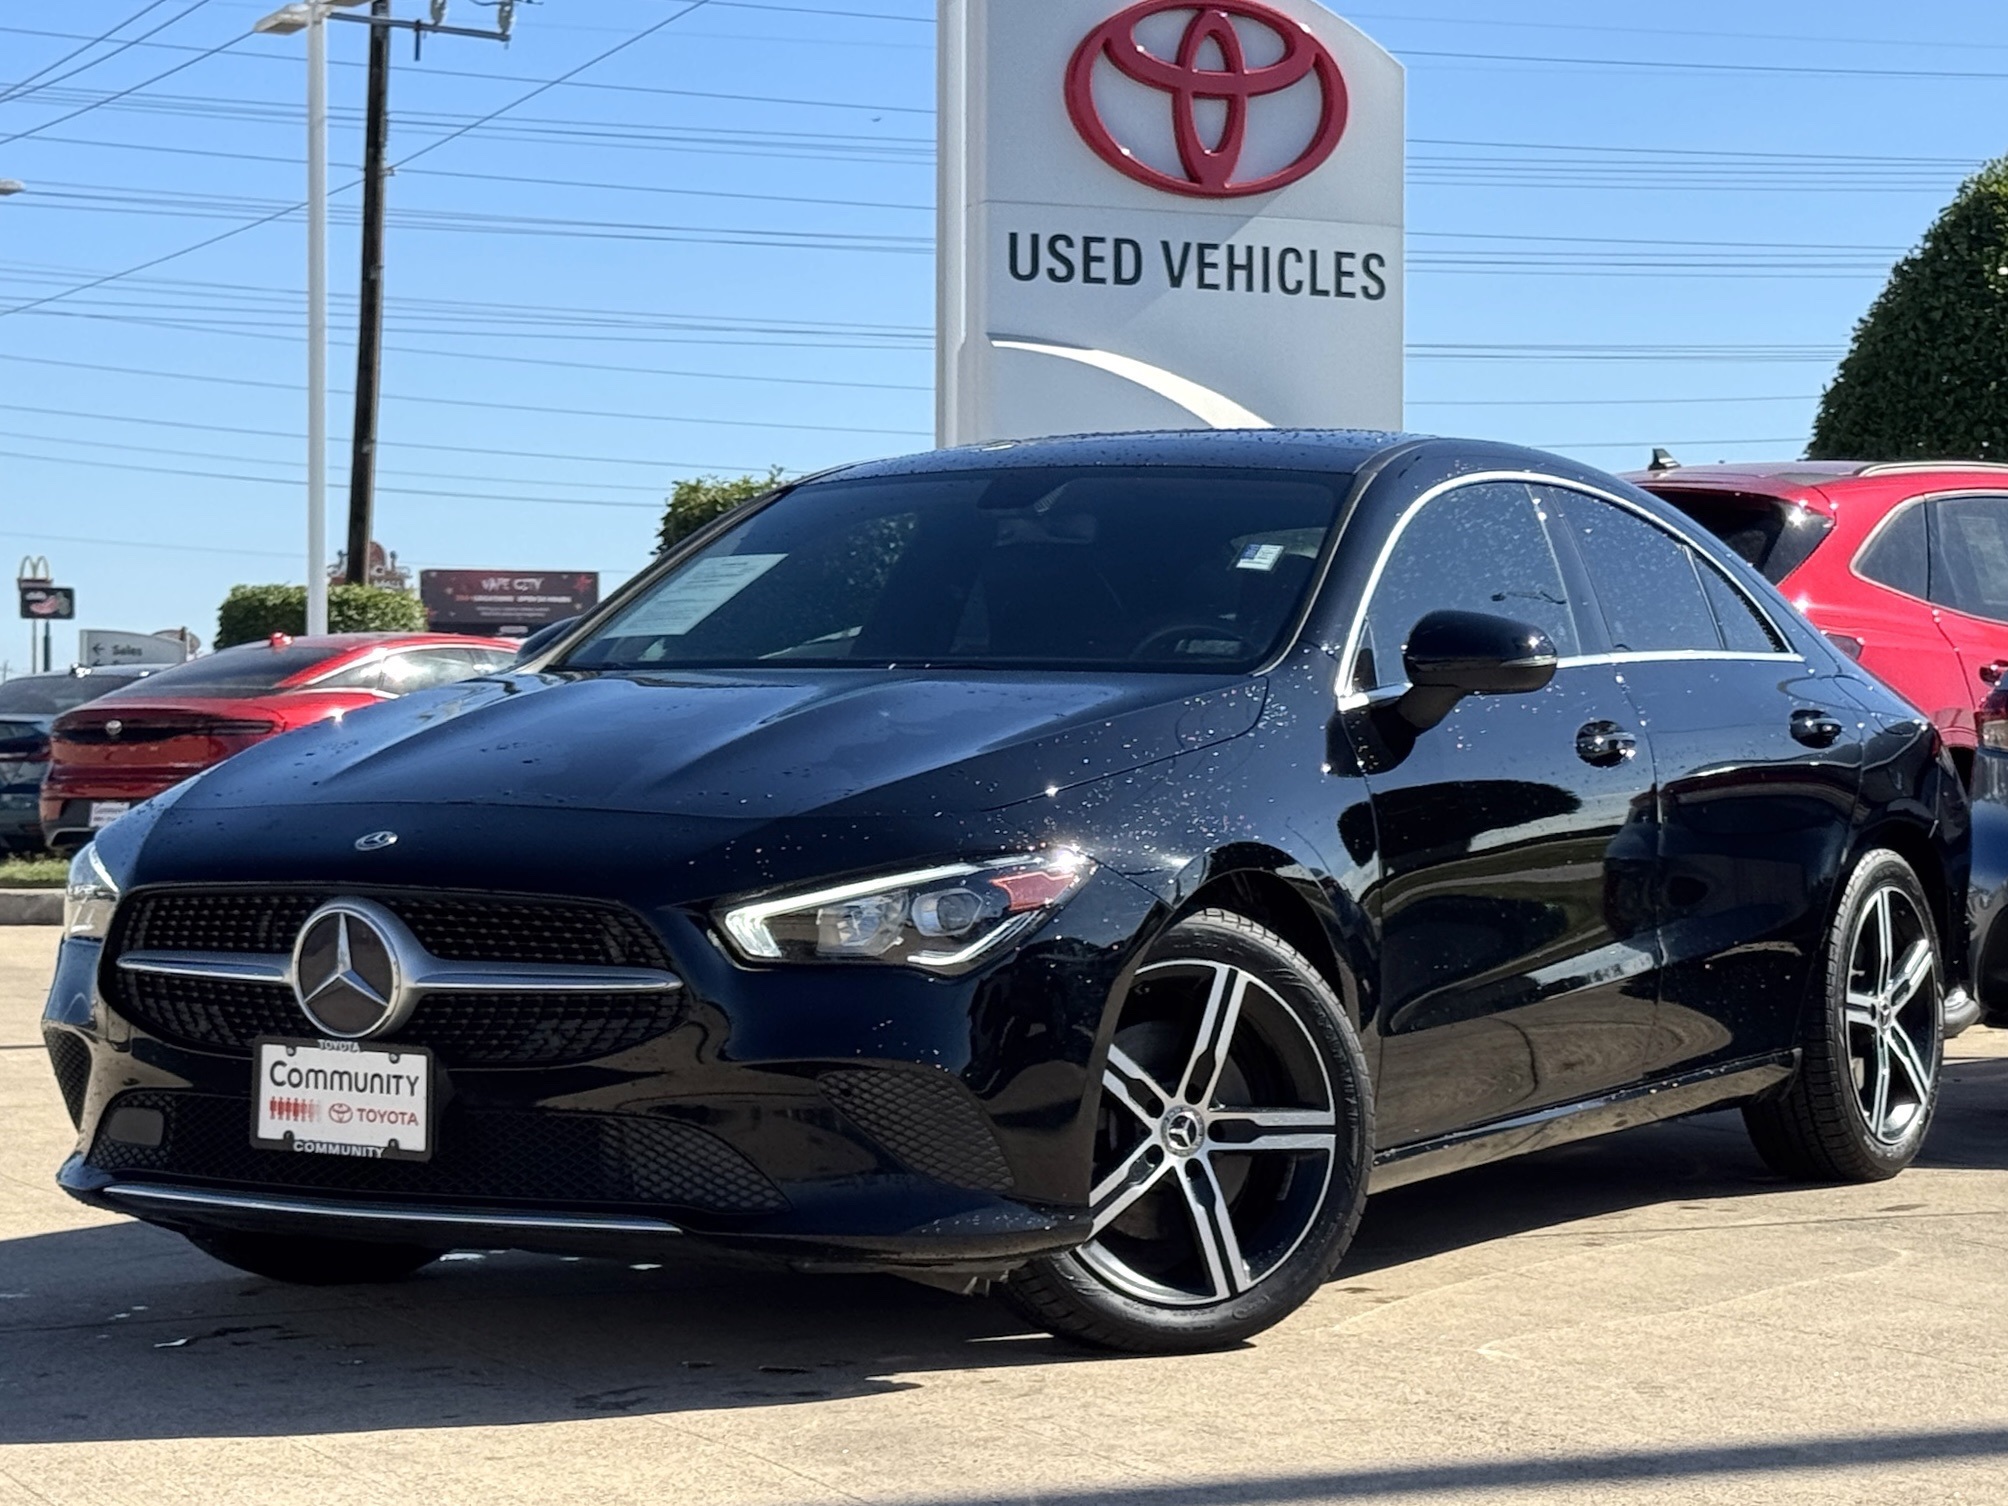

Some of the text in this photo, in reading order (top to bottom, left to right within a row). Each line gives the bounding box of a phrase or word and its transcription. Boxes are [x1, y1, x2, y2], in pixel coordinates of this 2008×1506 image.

[1009, 232, 1387, 301] USED VEHICLES
[112, 644, 143, 656] Sales
[317, 1039, 361, 1053] TOYOTA
[357, 1107, 420, 1127] TOYOTA
[292, 1139, 386, 1159] COMMUNITY
